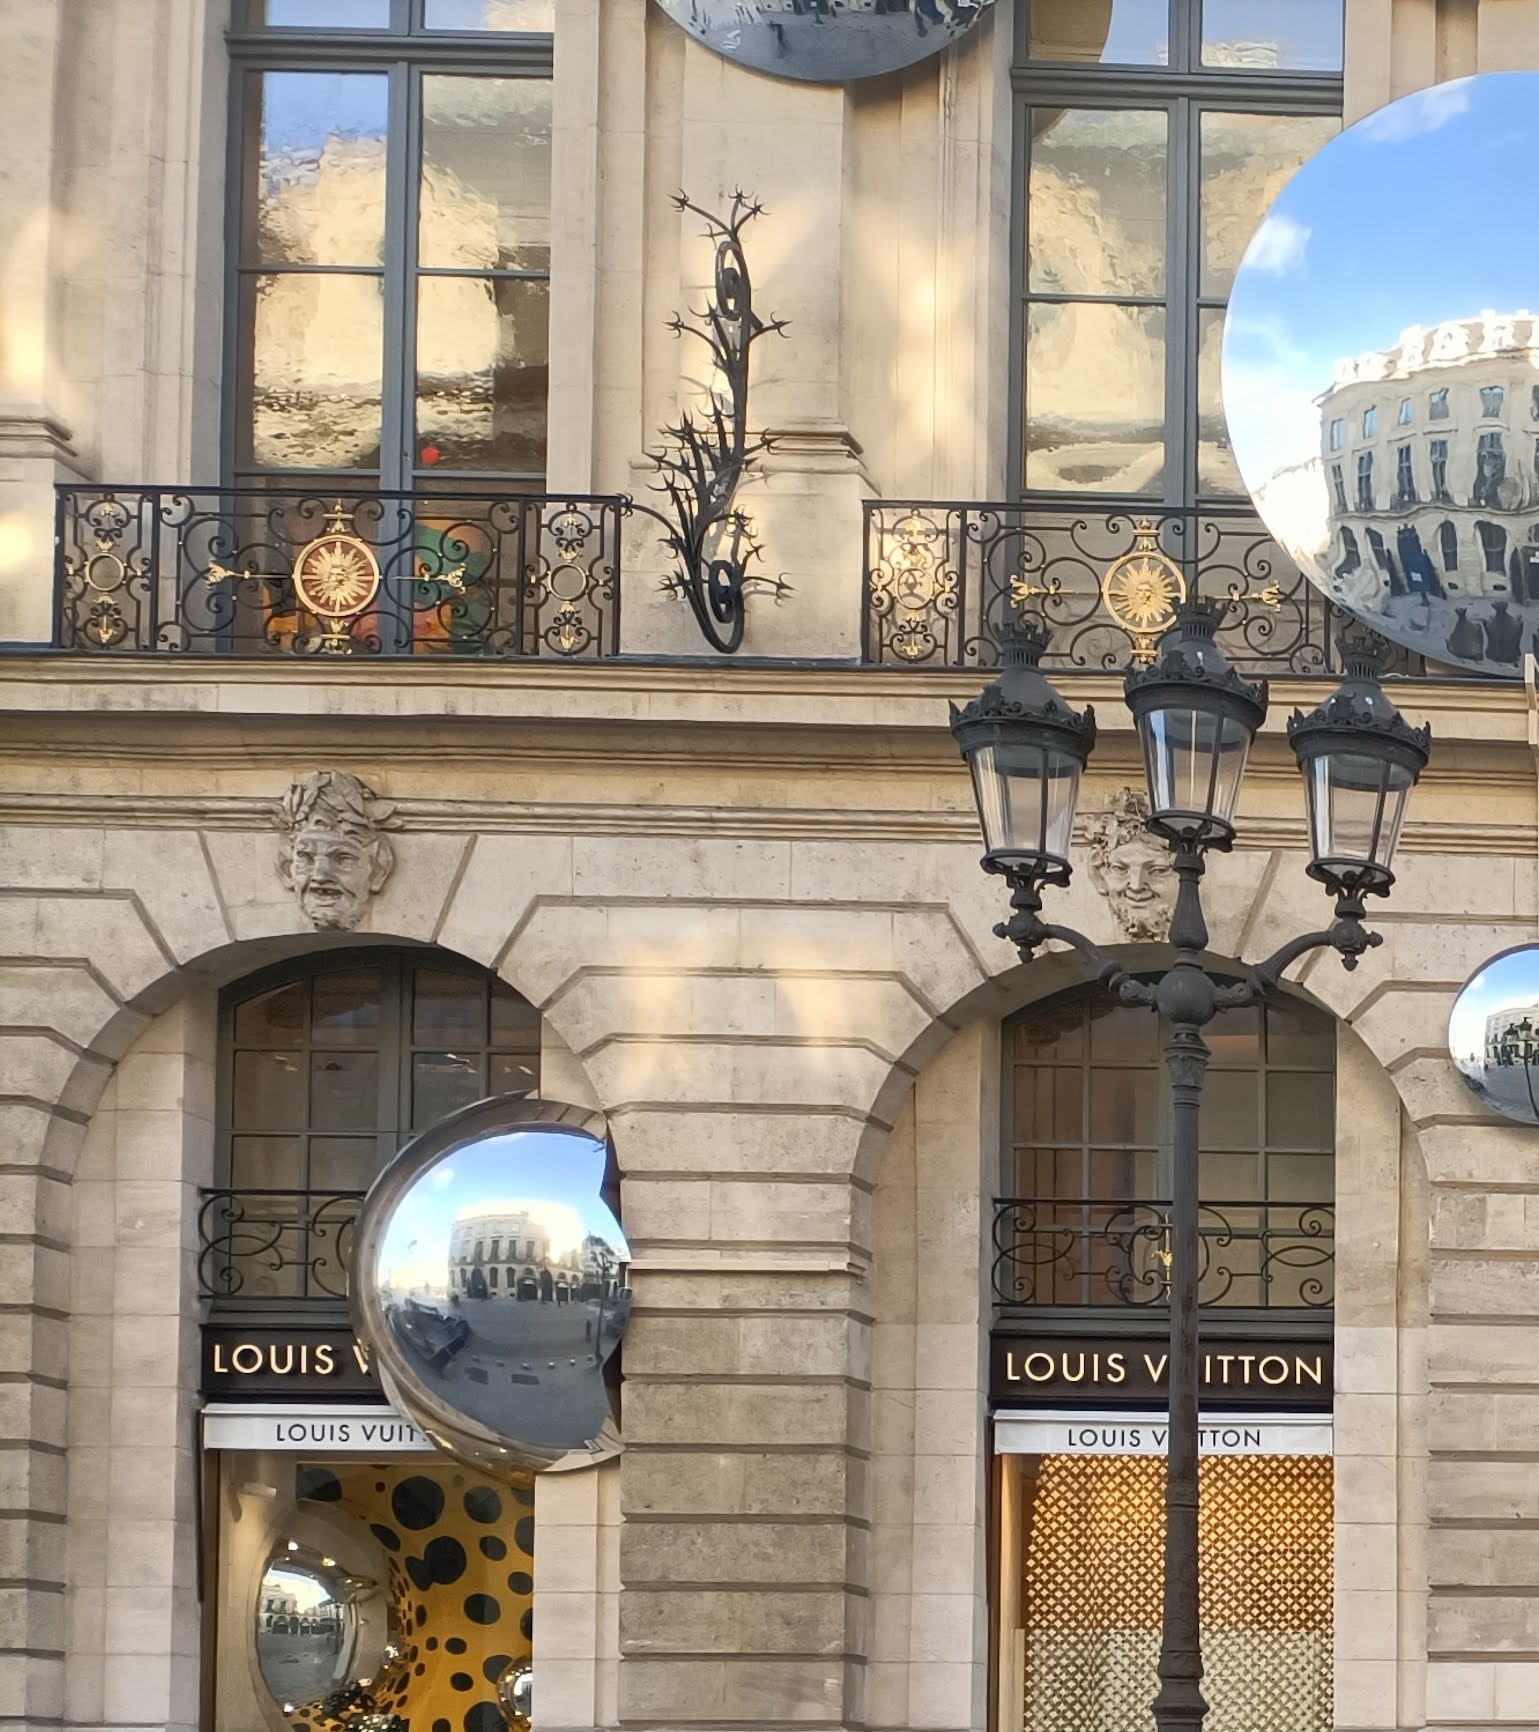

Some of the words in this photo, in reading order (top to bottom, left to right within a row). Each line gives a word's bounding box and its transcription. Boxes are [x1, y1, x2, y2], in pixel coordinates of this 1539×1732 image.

[213, 1343, 335, 1375] LOUIS
[1005, 1351, 1126, 1384] LOUIS
[1143, 1353, 1324, 1386] VITTON
[276, 1422, 351, 1443] LOUIS
[361, 1423, 416, 1443] VUIT
[1067, 1428, 1141, 1448] LOUIS
[1151, 1428, 1261, 1448] VTTON
